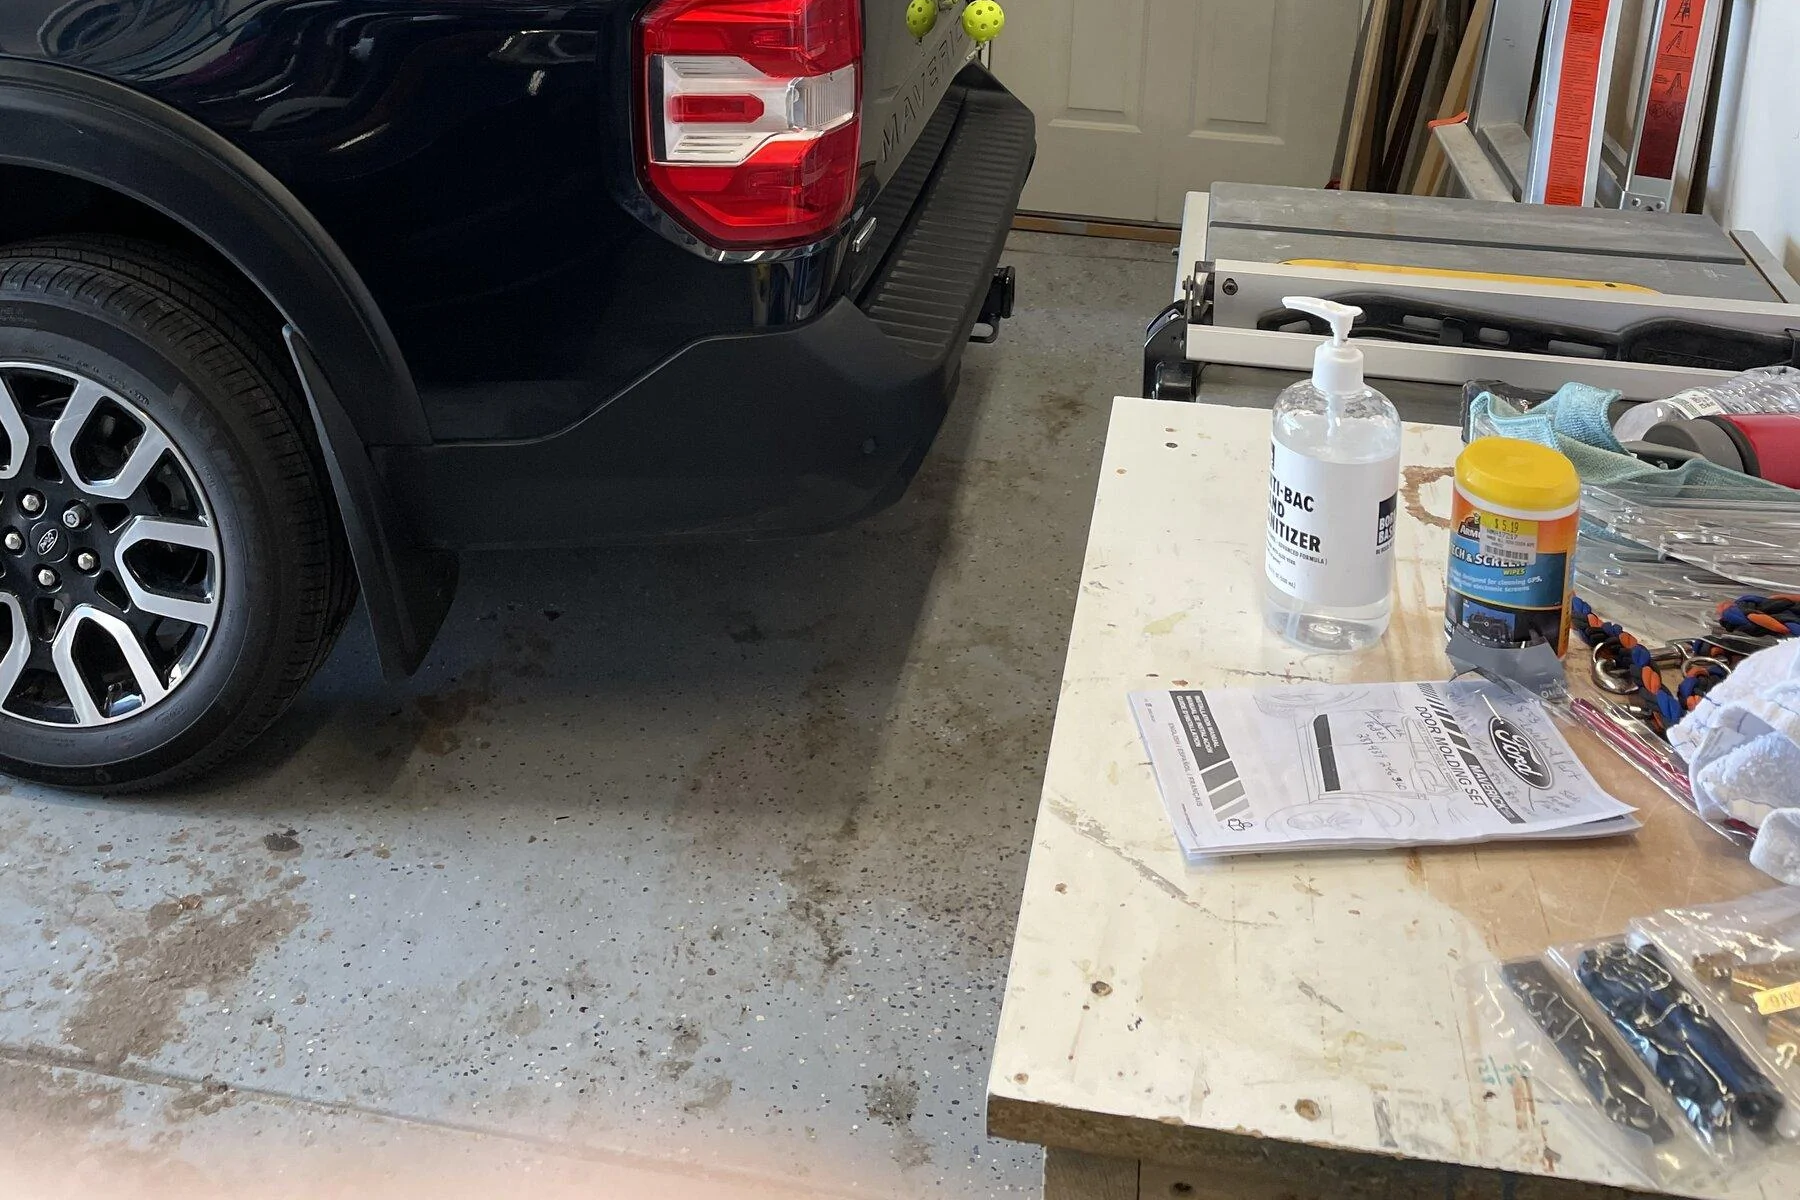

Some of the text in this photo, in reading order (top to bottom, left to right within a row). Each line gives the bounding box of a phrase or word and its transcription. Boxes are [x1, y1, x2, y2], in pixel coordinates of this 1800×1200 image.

[881, 15, 963, 164] MAVERIC
[1451, 544, 1466, 560] ECH
[1502, 568, 1526, 576] WIPES
[1168, 722, 1181, 744] ENGLISH
[1415, 705, 1442, 734] DOOR
[1433, 736, 1471, 786] MOLDING
[1465, 788, 1488, 808] SET
[1494, 729, 1543, 777] Ford
[1468, 763, 1507, 810] MAVERICK
